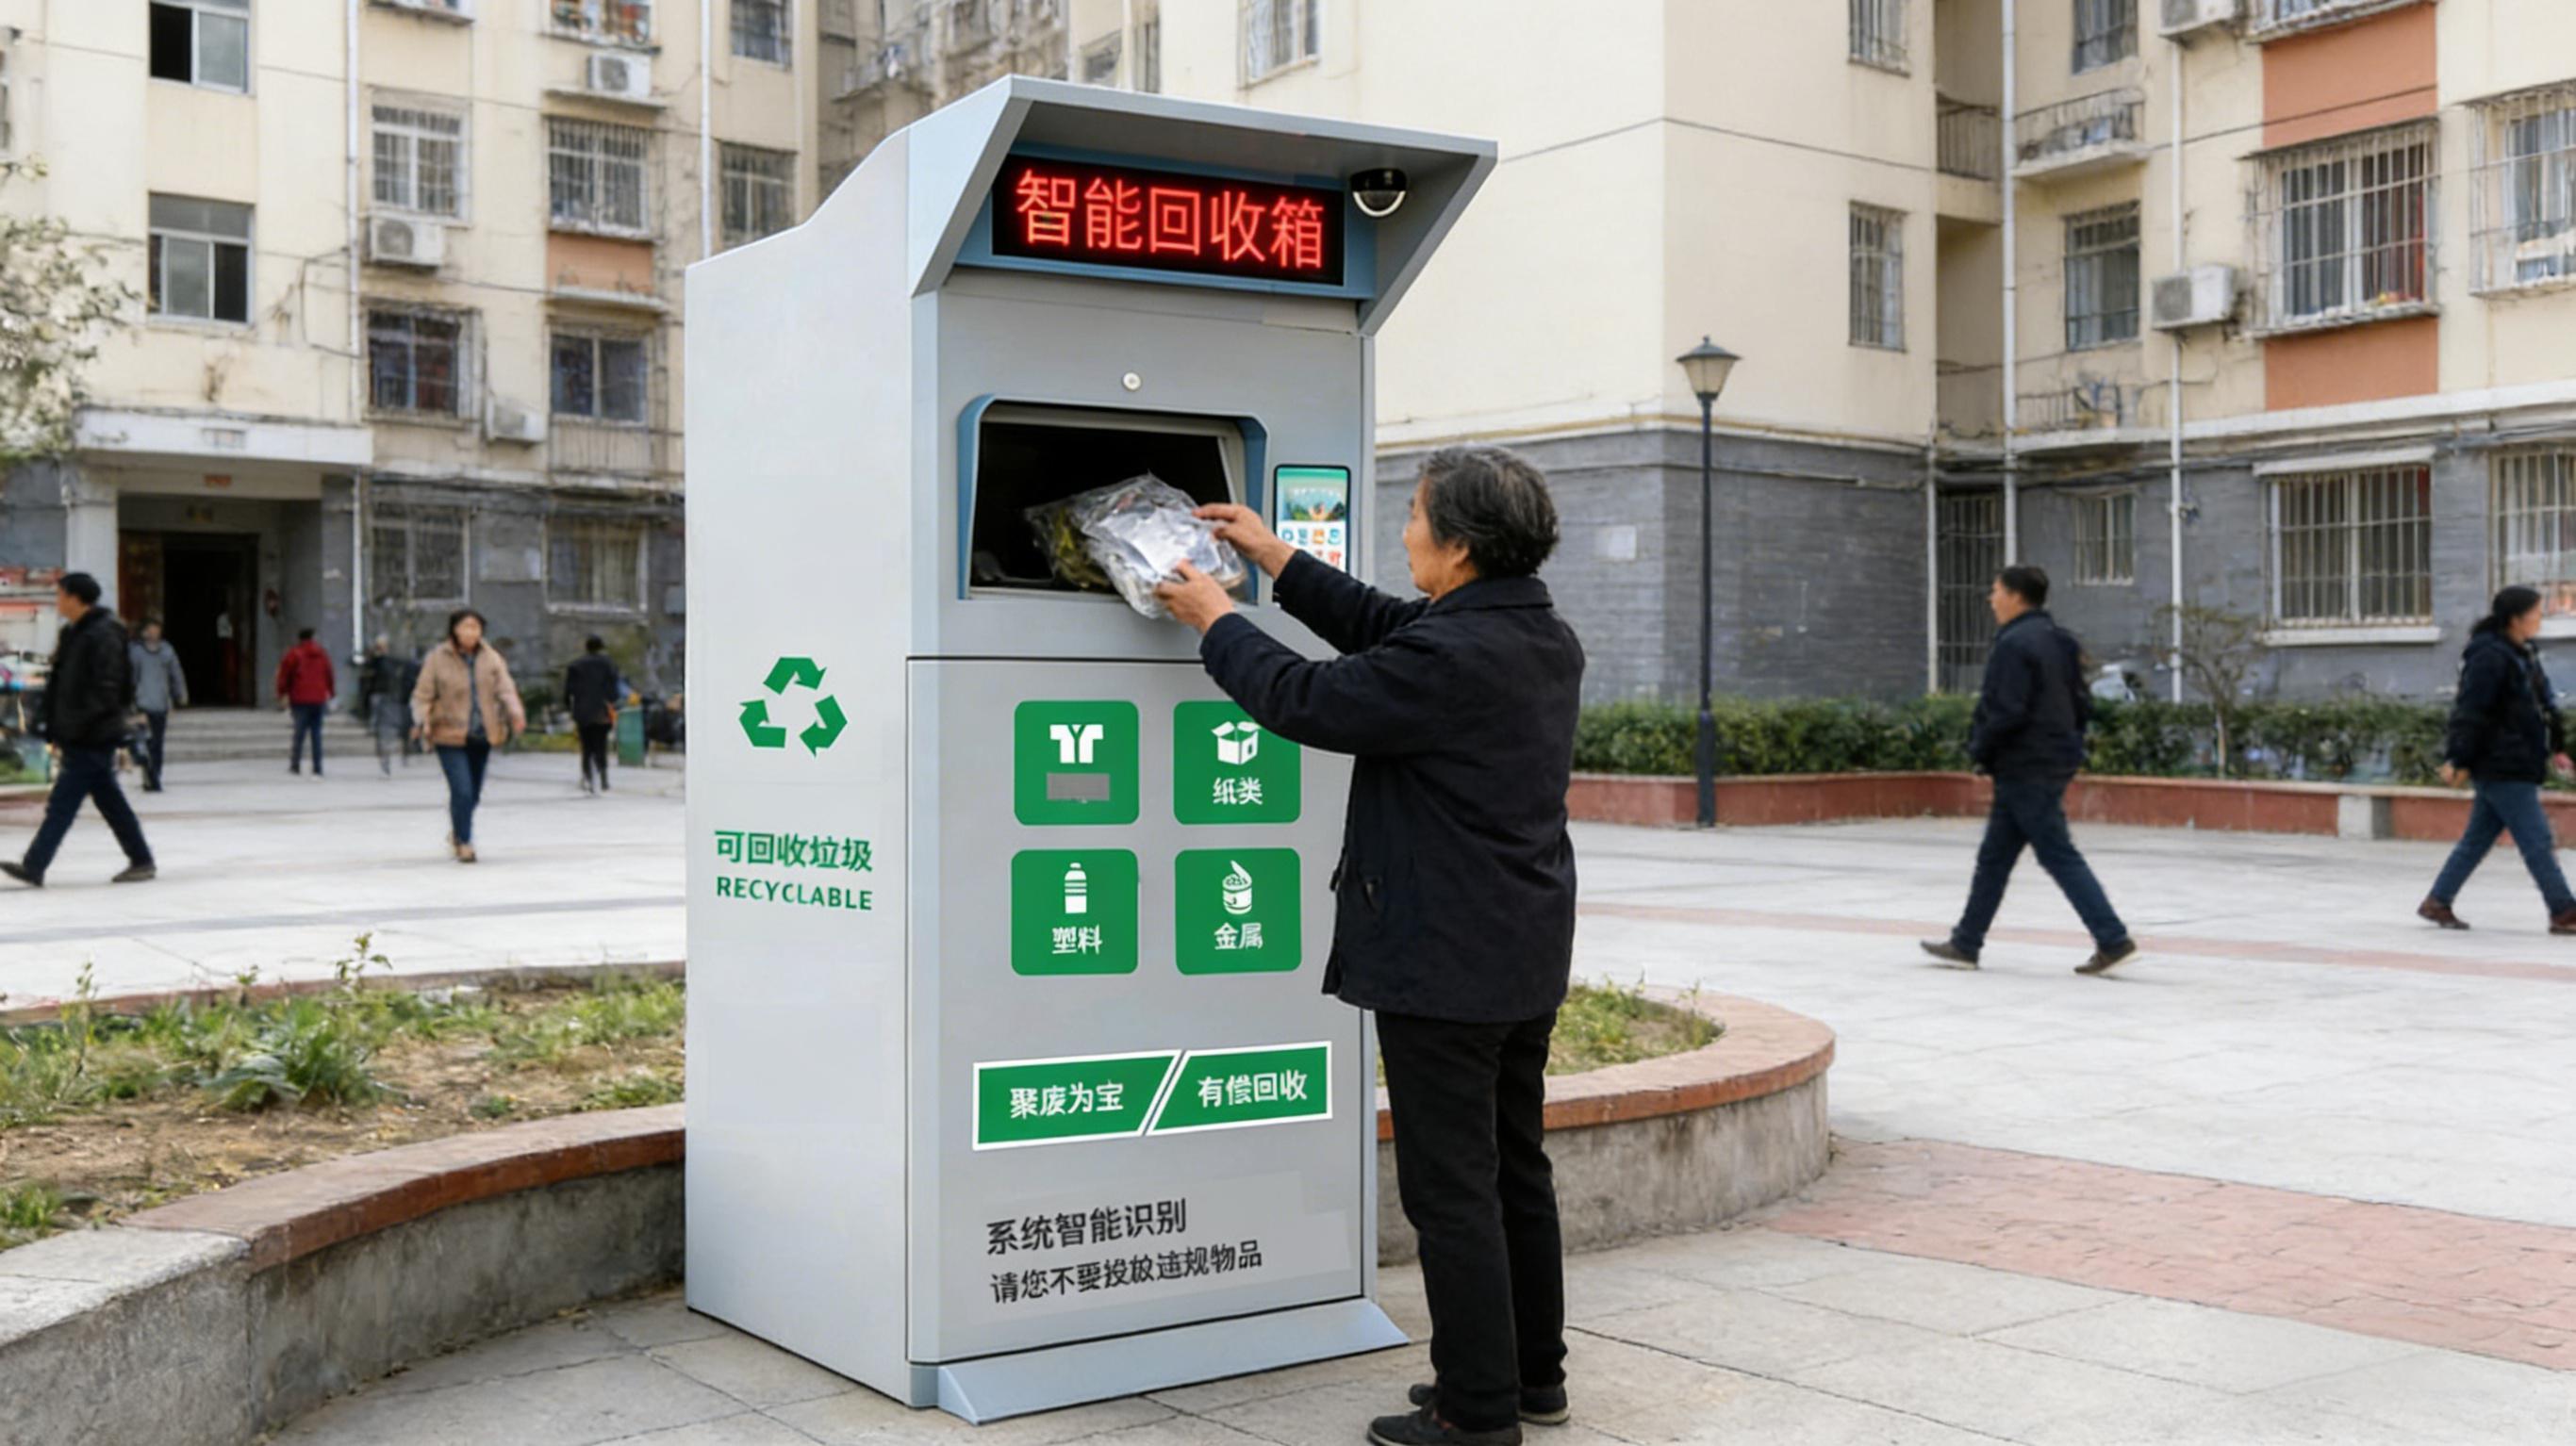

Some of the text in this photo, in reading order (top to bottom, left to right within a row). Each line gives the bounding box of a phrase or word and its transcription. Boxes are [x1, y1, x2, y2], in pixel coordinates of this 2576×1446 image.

[1016, 169, 1324, 270] 智能回收箱
[1213, 777, 1263, 805] 纸类
[715, 830, 873, 872] 可回收垃圾
[716, 877, 873, 911] RECYCLABLE
[1214, 922, 1263, 950] 金属
[1010, 1079, 1124, 1120] 聚废为宝
[1197, 1069, 1308, 1109] 有偿回收
[986, 1197, 1187, 1256] 系统智能识别
